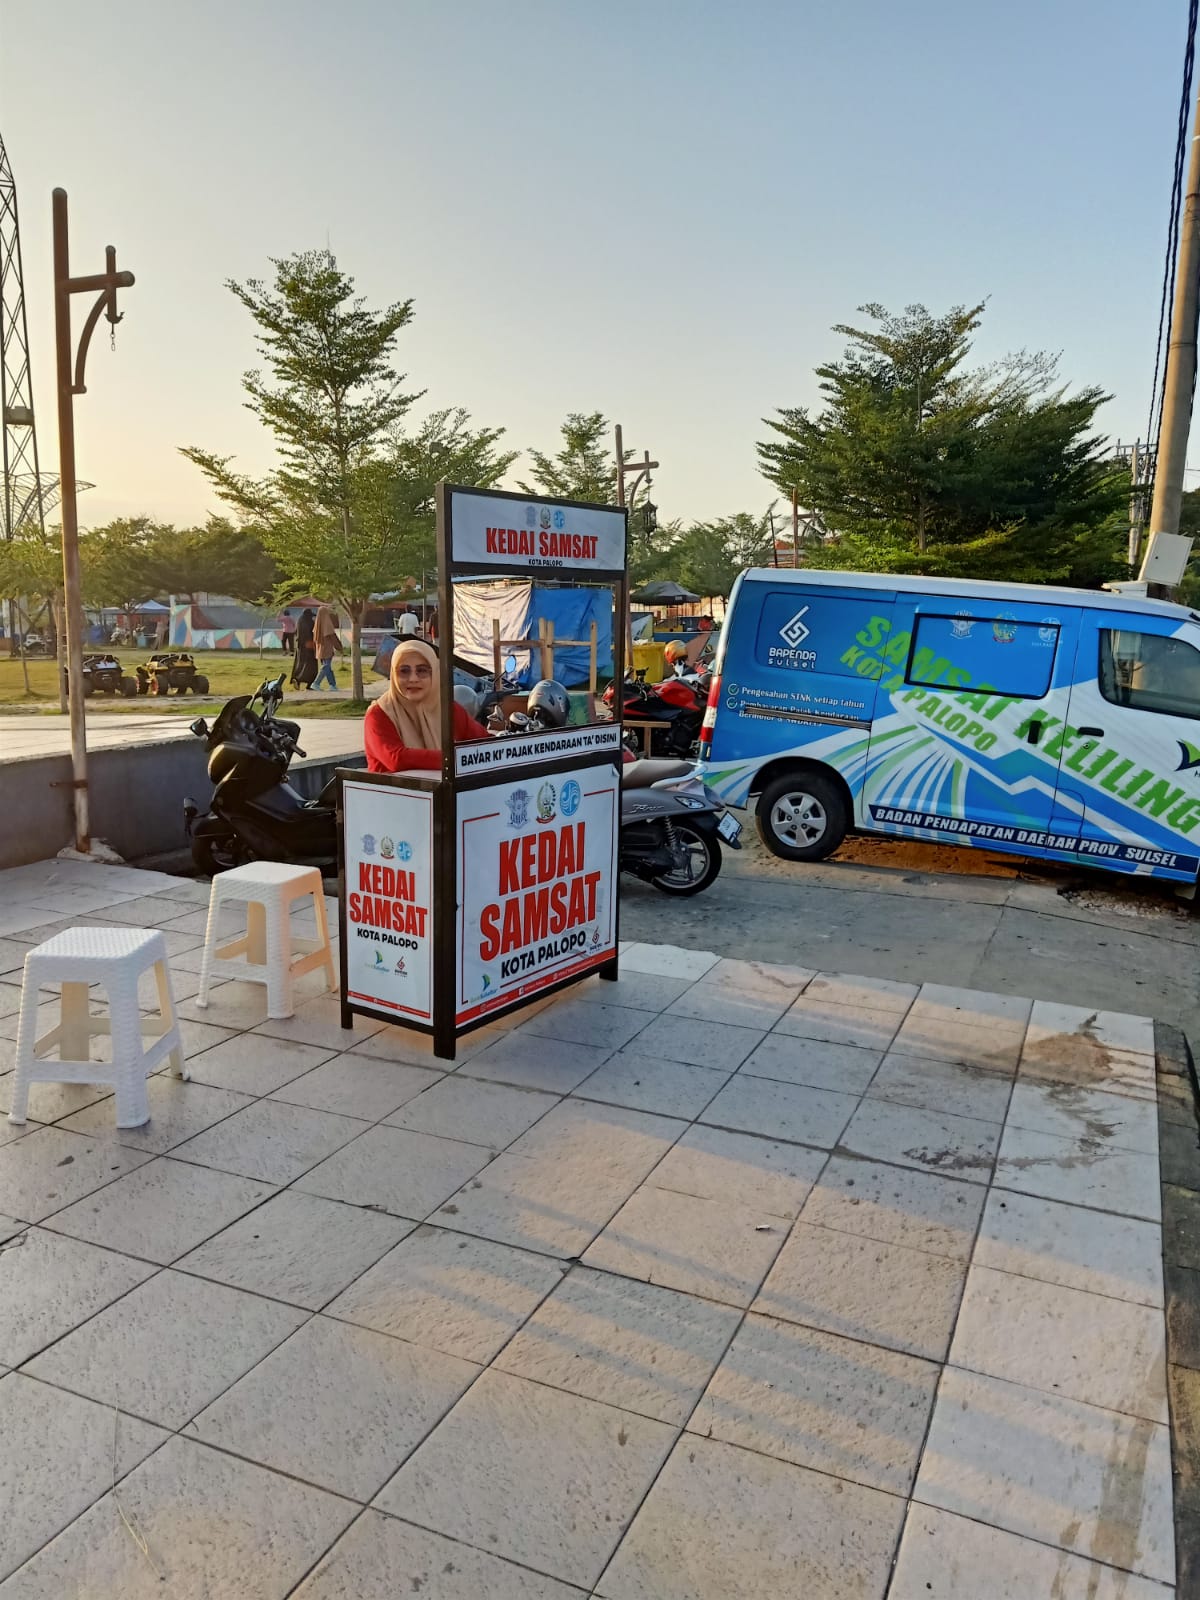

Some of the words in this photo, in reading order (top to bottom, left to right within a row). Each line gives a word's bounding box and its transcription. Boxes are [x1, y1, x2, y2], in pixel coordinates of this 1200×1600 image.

[486, 527, 535, 555] KEDAI
[539, 532, 598, 559] SAMSAT
[528, 558, 541, 566] KOTA
[769, 647, 817, 661] BAPENDA
[741, 686, 788, 700] Pengesahan
[790, 693, 811, 703] STNK
[813, 696, 839, 706] setiap
[840, 699, 865, 709] tahun
[839, 645, 905, 696] KOTA
[902, 686, 998, 752] PALOPO
[461, 751, 491, 766] BAYAR
[506, 744, 534, 759] PAJAK
[534, 738, 582, 755] KENDARAAN
[595, 732, 617, 745] DISINI
[1013, 708, 1200, 834] KELILING
[499, 821, 586, 896] KEDAI
[875, 808, 921, 826] BADAN
[923, 816, 1015, 841] PENDAPATAN
[1016, 831, 1076, 850] DAERAH
[1125, 846, 1177, 868] SULSEL
[358, 861, 416, 902] KEDAI
[349, 892, 428, 938] SAMSAT
[479, 870, 601, 962] SAMSAT
[357, 927, 380, 942] KOTA
[381, 932, 419, 951] PALOPO
[501, 950, 535, 979] KOTA
[538, 930, 587, 964] PALOPO
